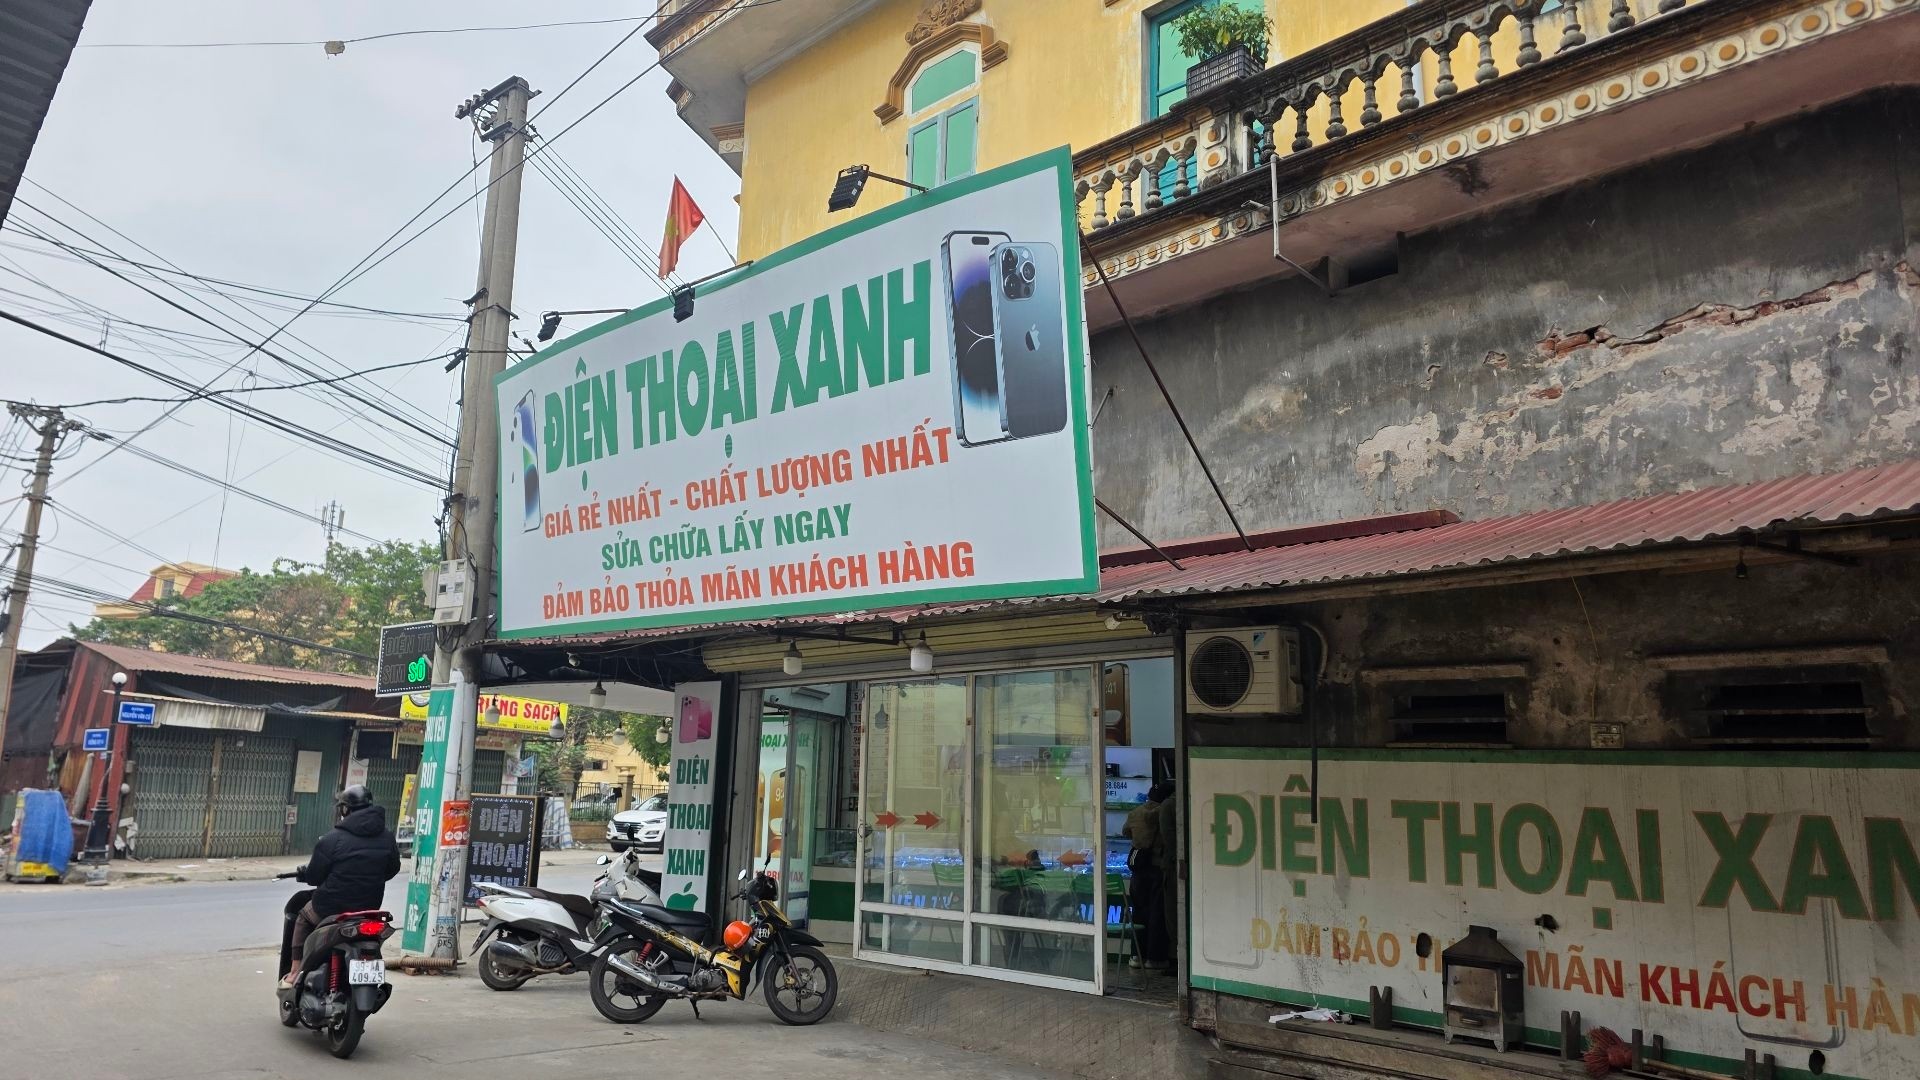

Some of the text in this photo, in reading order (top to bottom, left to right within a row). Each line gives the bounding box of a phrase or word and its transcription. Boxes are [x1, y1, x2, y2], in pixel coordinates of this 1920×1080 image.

[543, 259, 932, 491] ĐIỆN THOẠI XANH
[544, 501, 573, 539] GIÁ
[577, 492, 602, 532] RẺ
[608, 481, 662, 528] NHẤT
[685, 463, 749, 511] CHẤT
[756, 448, 853, 500] LƯỢNG
[862, 417, 952, 479] NHẤT
[601, 503, 853, 571] SỬA CHỮA LẤY NGAY
[543, 538, 975, 620] ĐẢM BẢO THỎA MÃN KHÁCH HÀNG
[761, 734, 782, 752] HOẠI
[420, 756, 438, 789] RÚT
[676, 755, 710, 790] ĐIỆN
[479, 803, 523, 838] ĐIỆN
[669, 803, 713, 836] THOẠI
[471, 841, 525, 873] THOẠI
[667, 848, 706, 877] XANH
[1210, 773, 1371, 898] ĐIỆN
[1391, 799, 1665, 930] THOẠI
[352, 972, 383, 983] 409.25
[1250, 906, 1322, 958] ĐẢM
[1331, 915, 1402, 968] BẢO
[1526, 942, 1626, 999] MÃN
[1639, 960, 1807, 1023] KHÁCH
